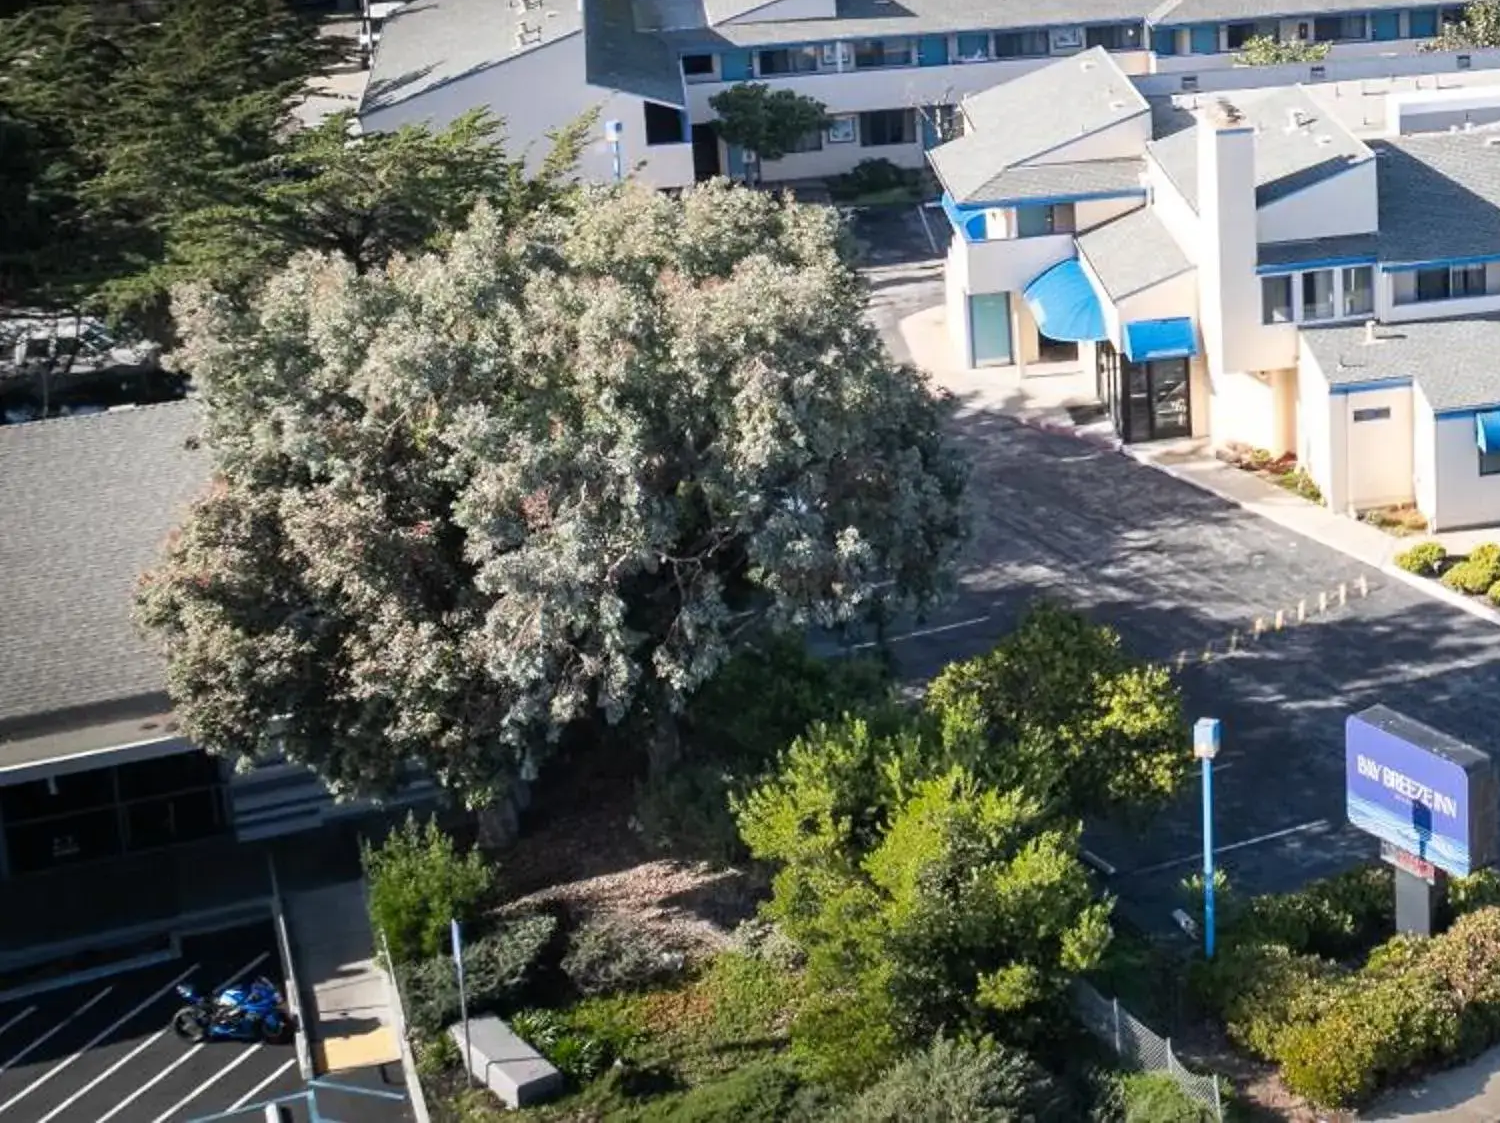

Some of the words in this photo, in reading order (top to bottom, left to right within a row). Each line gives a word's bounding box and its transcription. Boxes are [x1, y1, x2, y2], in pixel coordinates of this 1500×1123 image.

[1357, 754, 1382, 782] BAY
[1382, 765, 1433, 810] BREEZE
[1433, 791, 1457, 818] INN
